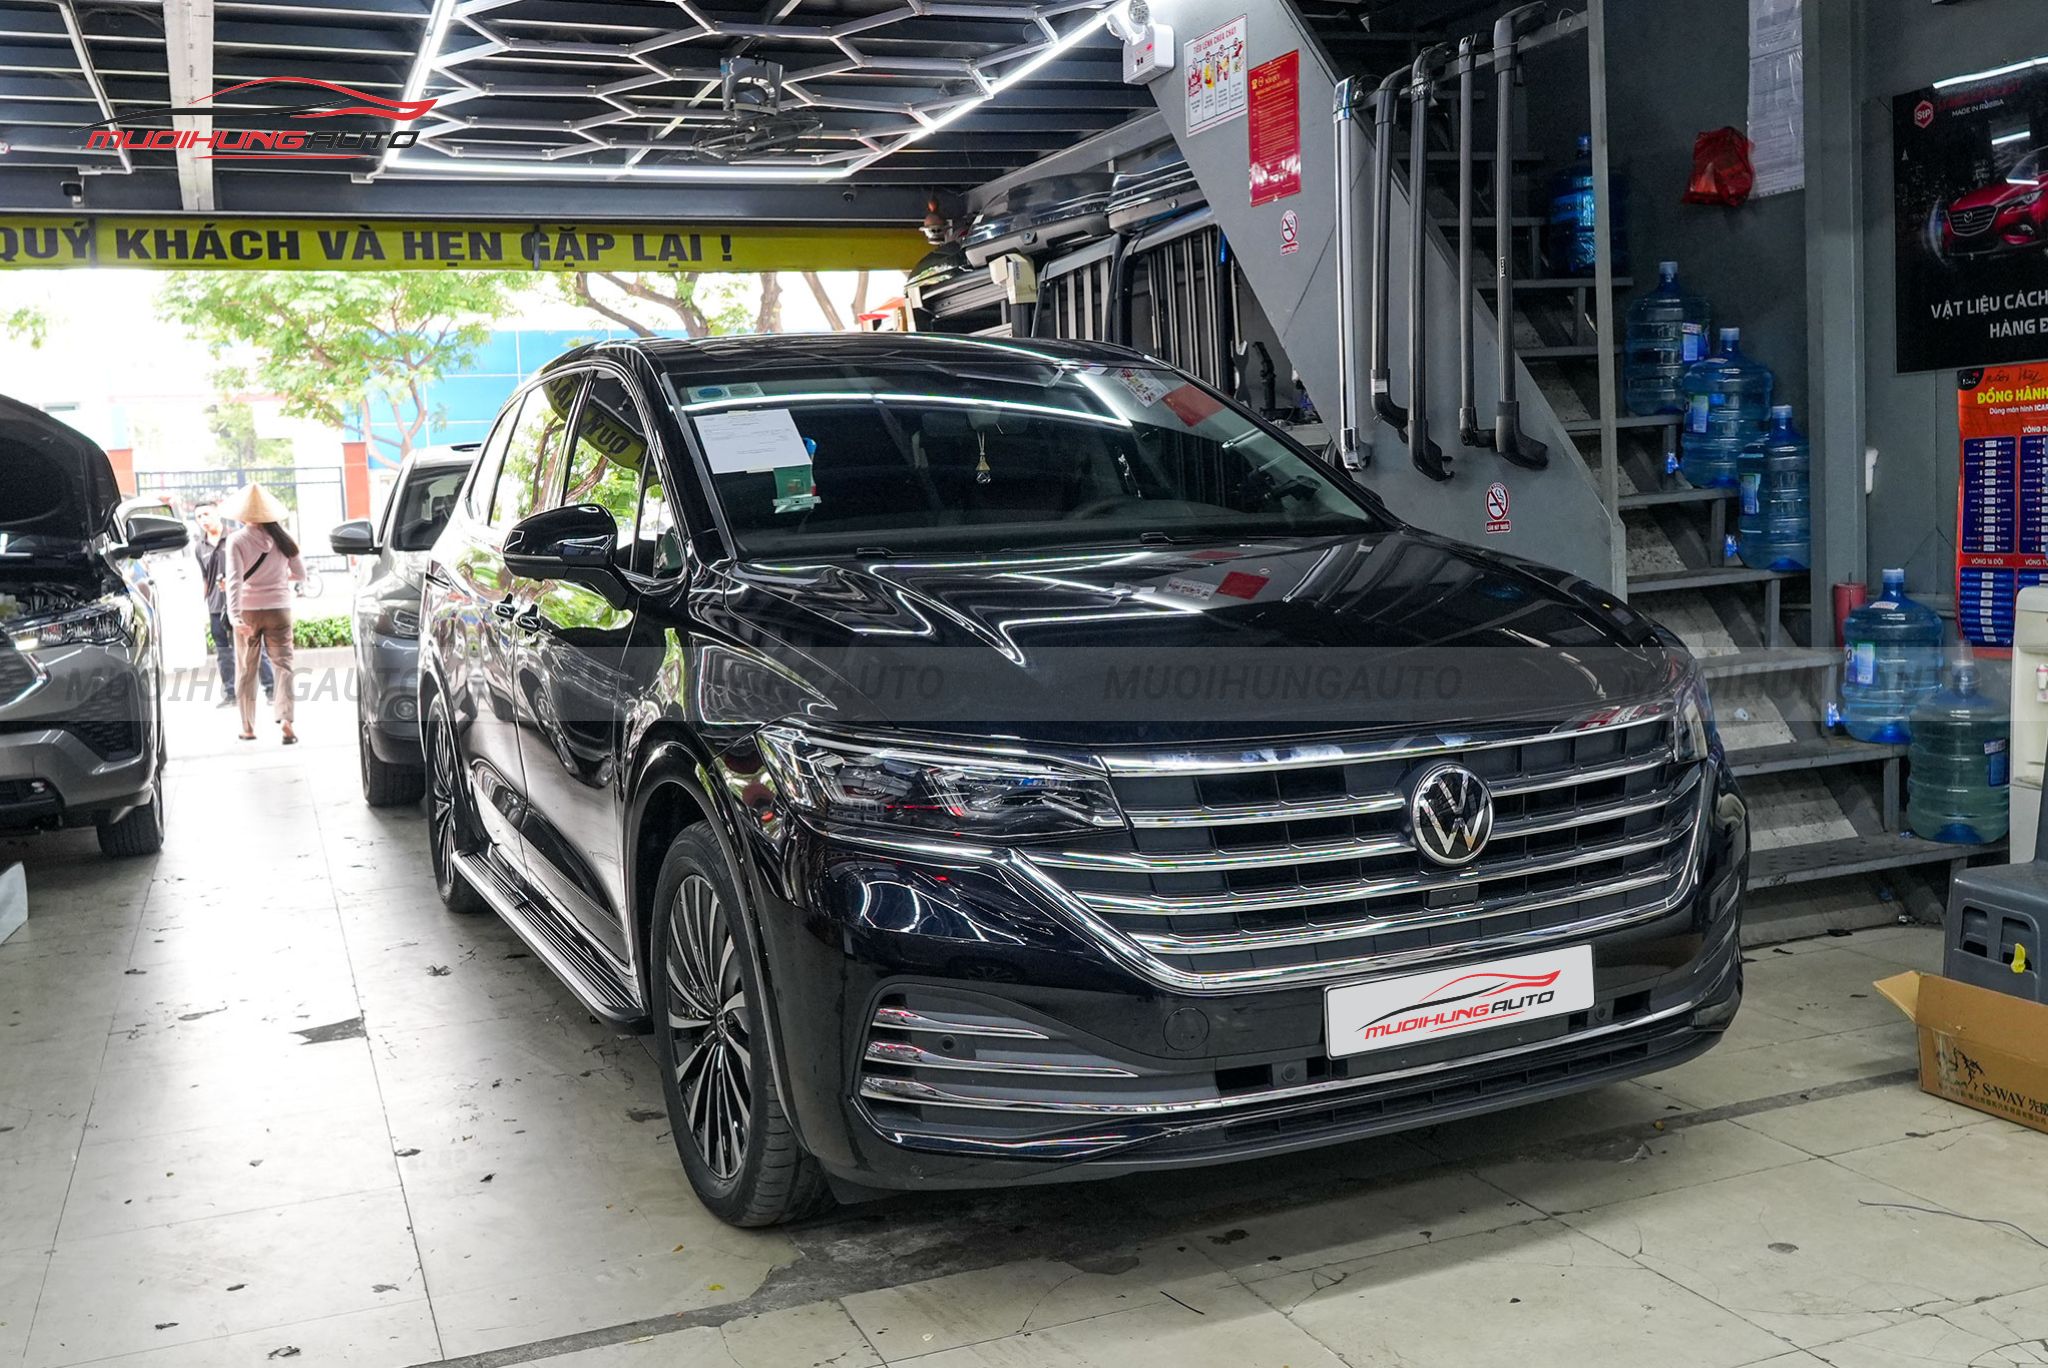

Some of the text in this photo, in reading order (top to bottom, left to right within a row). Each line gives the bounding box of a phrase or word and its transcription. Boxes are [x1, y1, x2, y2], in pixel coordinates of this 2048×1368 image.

[1951, 106, 1971, 117] MADE
[115, 223, 301, 260] KHÁCH
[317, 223, 386, 261] VÀ
[402, 230, 503, 267] HẸN
[520, 226, 616, 268] GẶP
[632, 233, 703, 268] LẠI
[1930, 289, 2048, 320] VẬT LIỆU CÁCH
[1989, 318, 2036, 339] HÀNG
[1977, 385, 2048, 405] ĐỒNG HÀNH
[1989, 407, 2006, 416] Dùng
[1982, 1083, 2026, 1108] S-WAY
